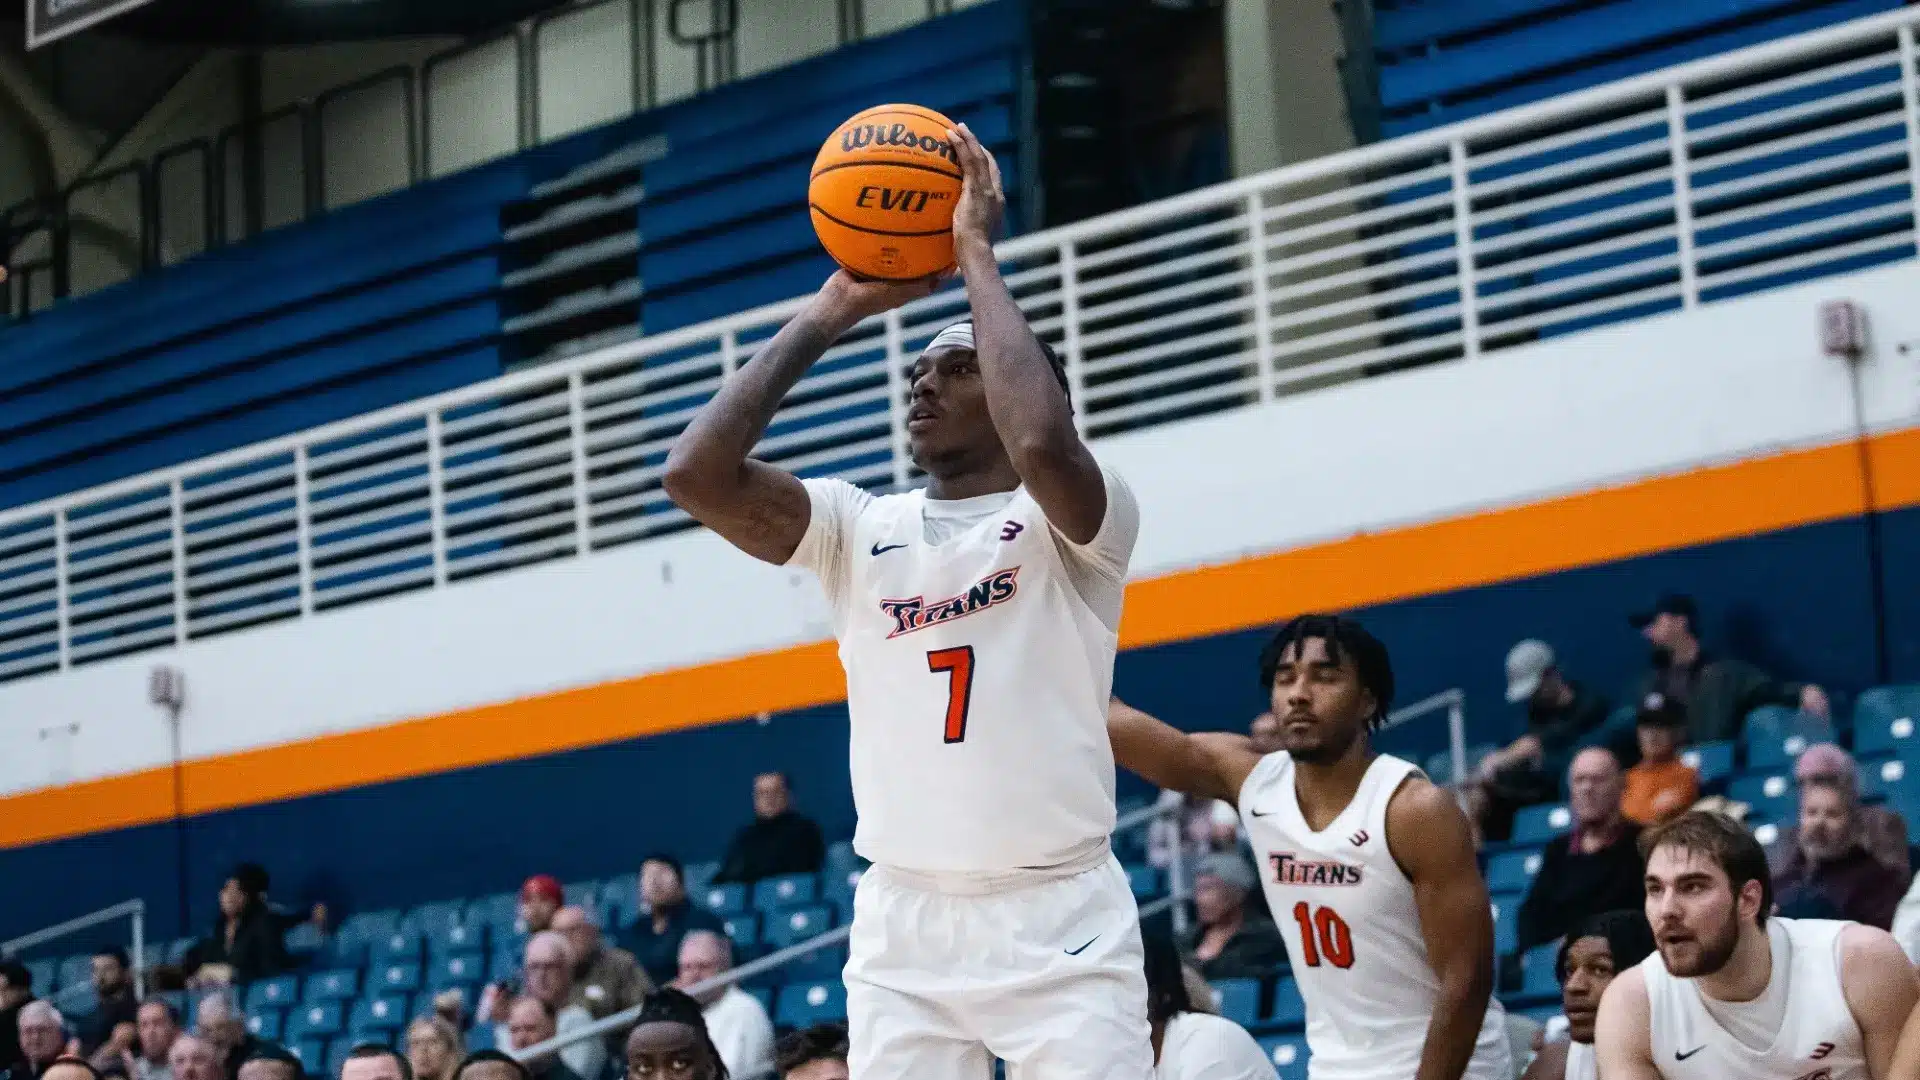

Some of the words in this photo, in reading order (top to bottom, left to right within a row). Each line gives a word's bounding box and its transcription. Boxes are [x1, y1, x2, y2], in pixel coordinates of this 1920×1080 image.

[841, 123, 957, 164] Wilson
[881, 567, 1019, 637] TITANS
[926, 645, 975, 744] 7
[1269, 853, 1363, 885] TITANS
[1293, 901, 1355, 969] 10
